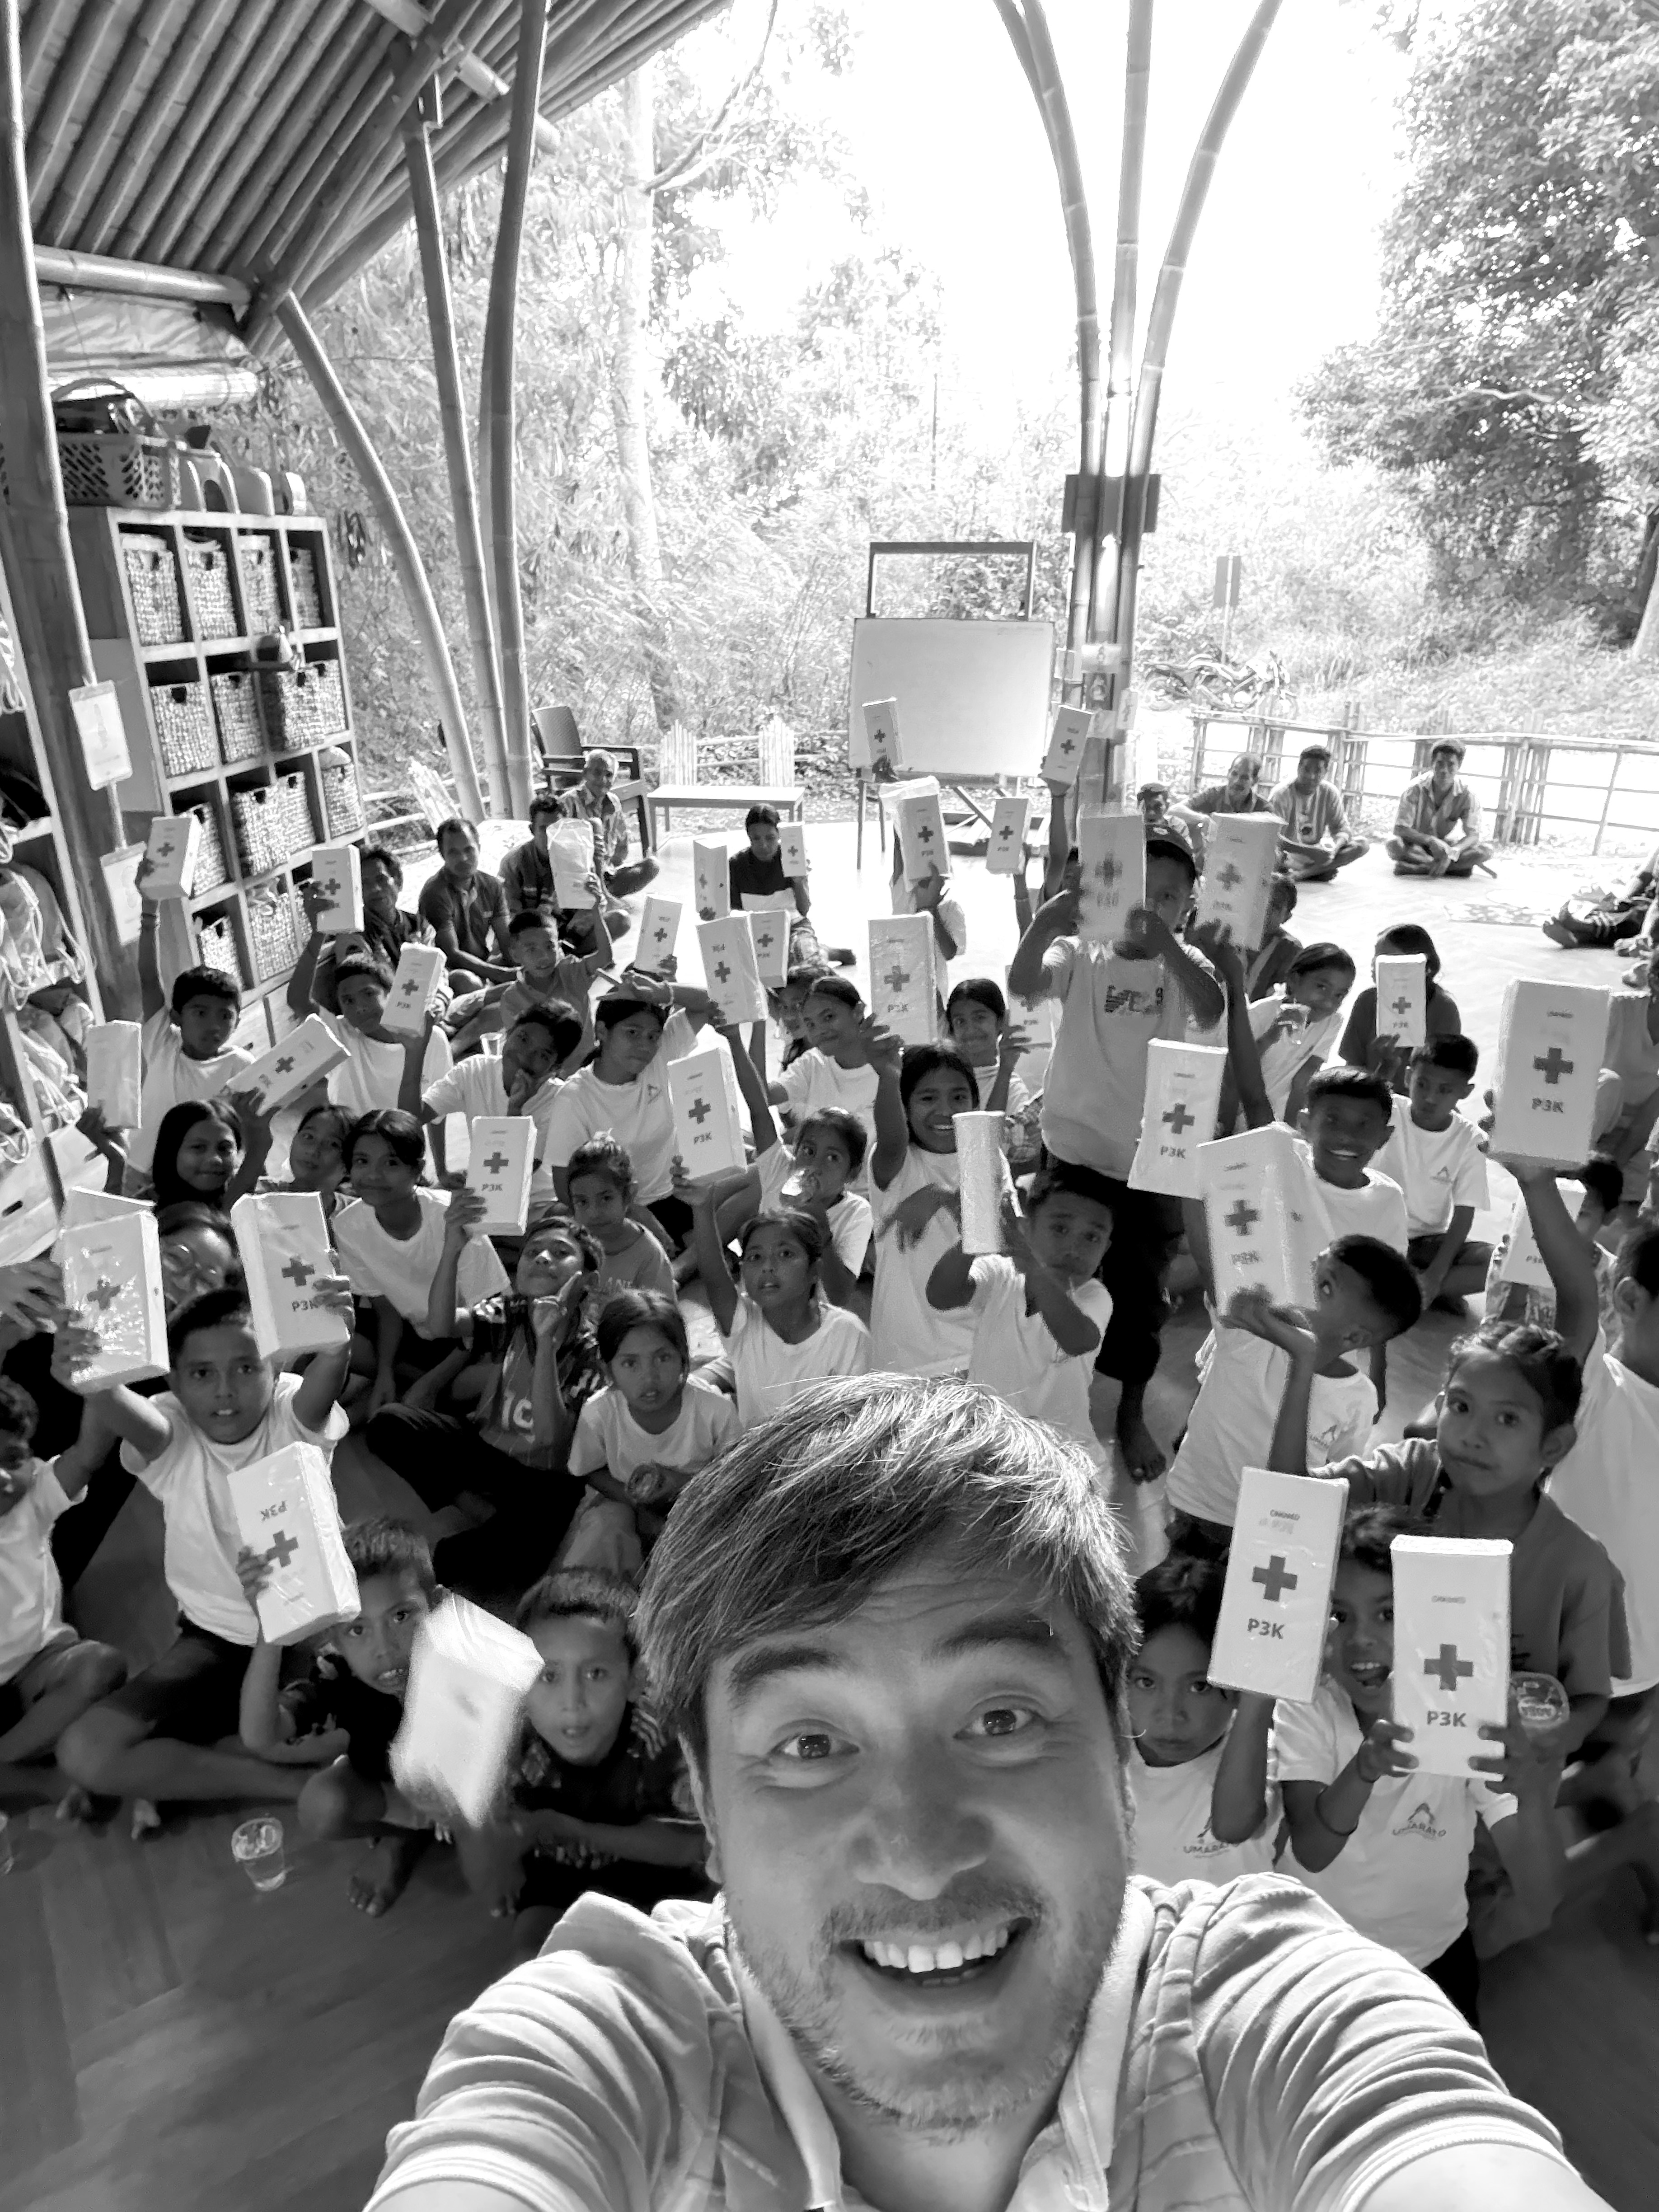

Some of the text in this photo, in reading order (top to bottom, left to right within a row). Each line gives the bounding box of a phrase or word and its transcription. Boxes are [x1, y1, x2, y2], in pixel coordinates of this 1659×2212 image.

[1532, 1098, 1564, 1113] P3K
[694, 1132, 712, 1145] P3K
[1160, 1145, 1187, 1160] P3K
[481, 1183, 503, 1192] P3K
[260, 1500, 288, 1521] P3K
[1247, 1617, 1285, 1640] P3K
[1427, 1710, 1467, 1728] P3K
[1183, 1842, 1240, 1854] UMARA
